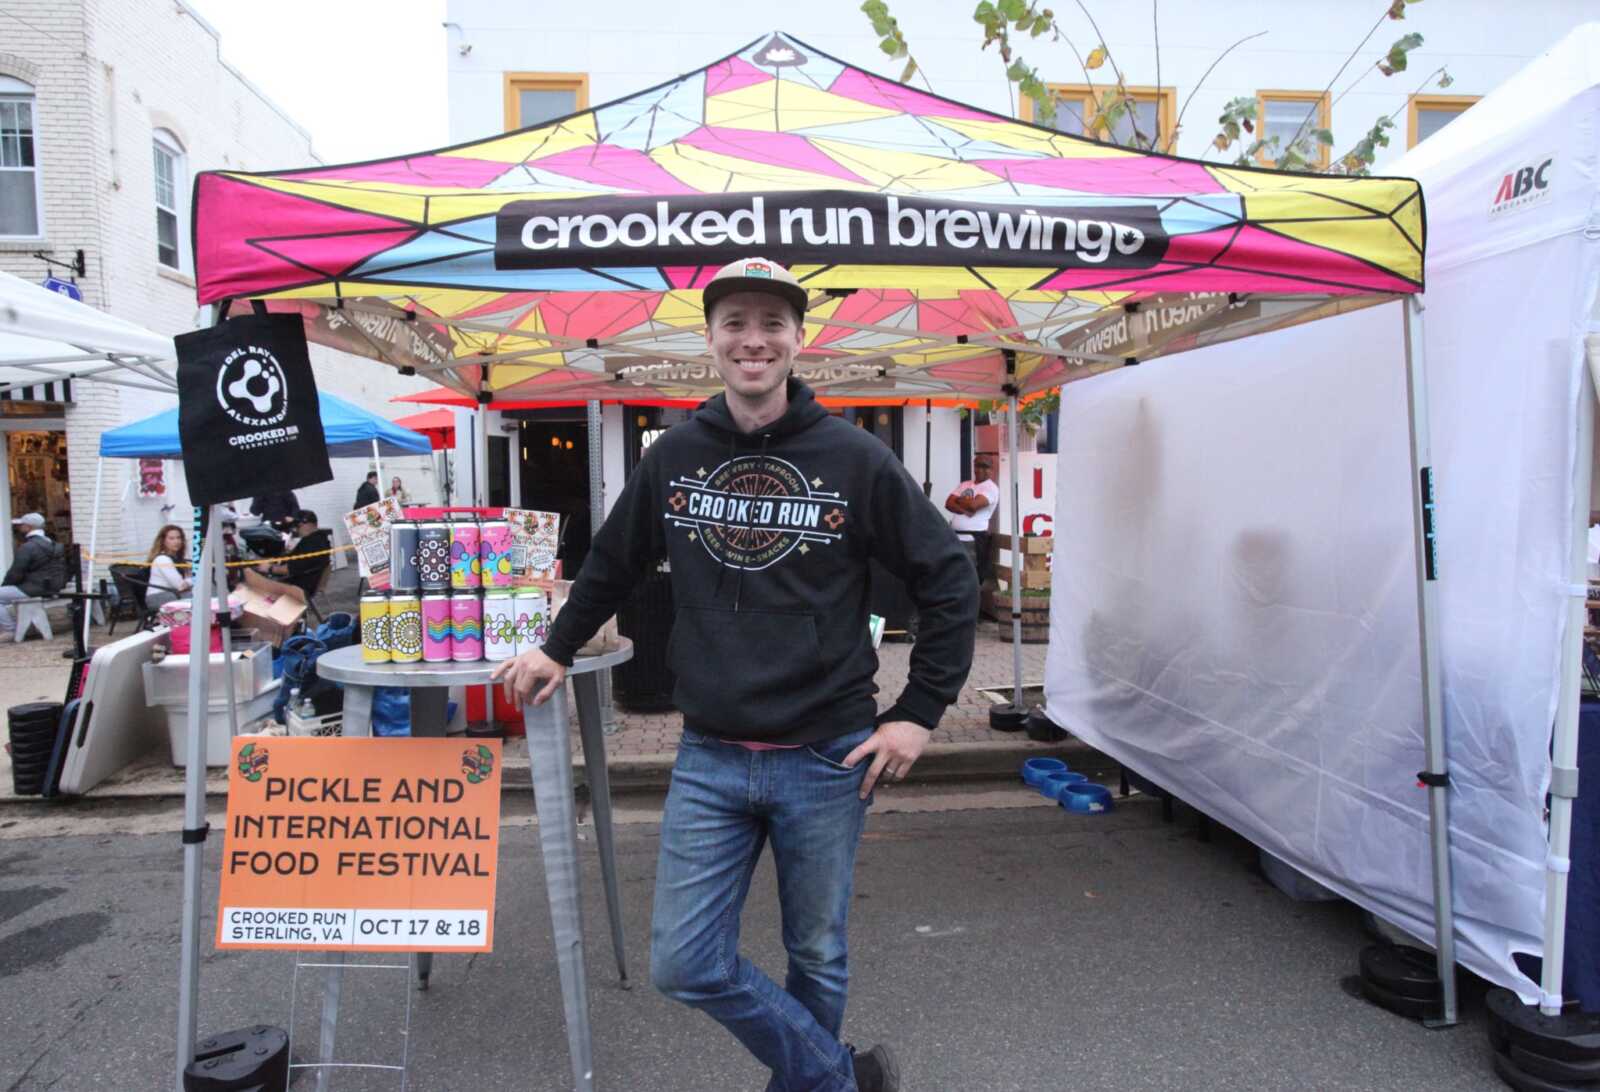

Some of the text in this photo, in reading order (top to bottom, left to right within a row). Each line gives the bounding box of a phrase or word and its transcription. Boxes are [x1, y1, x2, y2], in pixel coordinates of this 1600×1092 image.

[1494, 159, 1552, 205] ABC
[521, 196, 1112, 263] crooked run brewing
[224, 345, 270, 365] DEL RAY
[229, 428, 286, 446] CROOKED
[642, 429, 666, 448] OP
[688, 492, 821, 527] CROOKED RUN
[265, 777, 465, 803] PICKLE AND
[234, 815, 490, 840] INTERNATIONAL
[230, 851, 490, 877] FOOD FESTIVAL
[231, 911, 346, 925] CROOKED RUN
[360, 919, 480, 936] OCT 17 & 18
[232, 926, 343, 942] STERLING, VA
